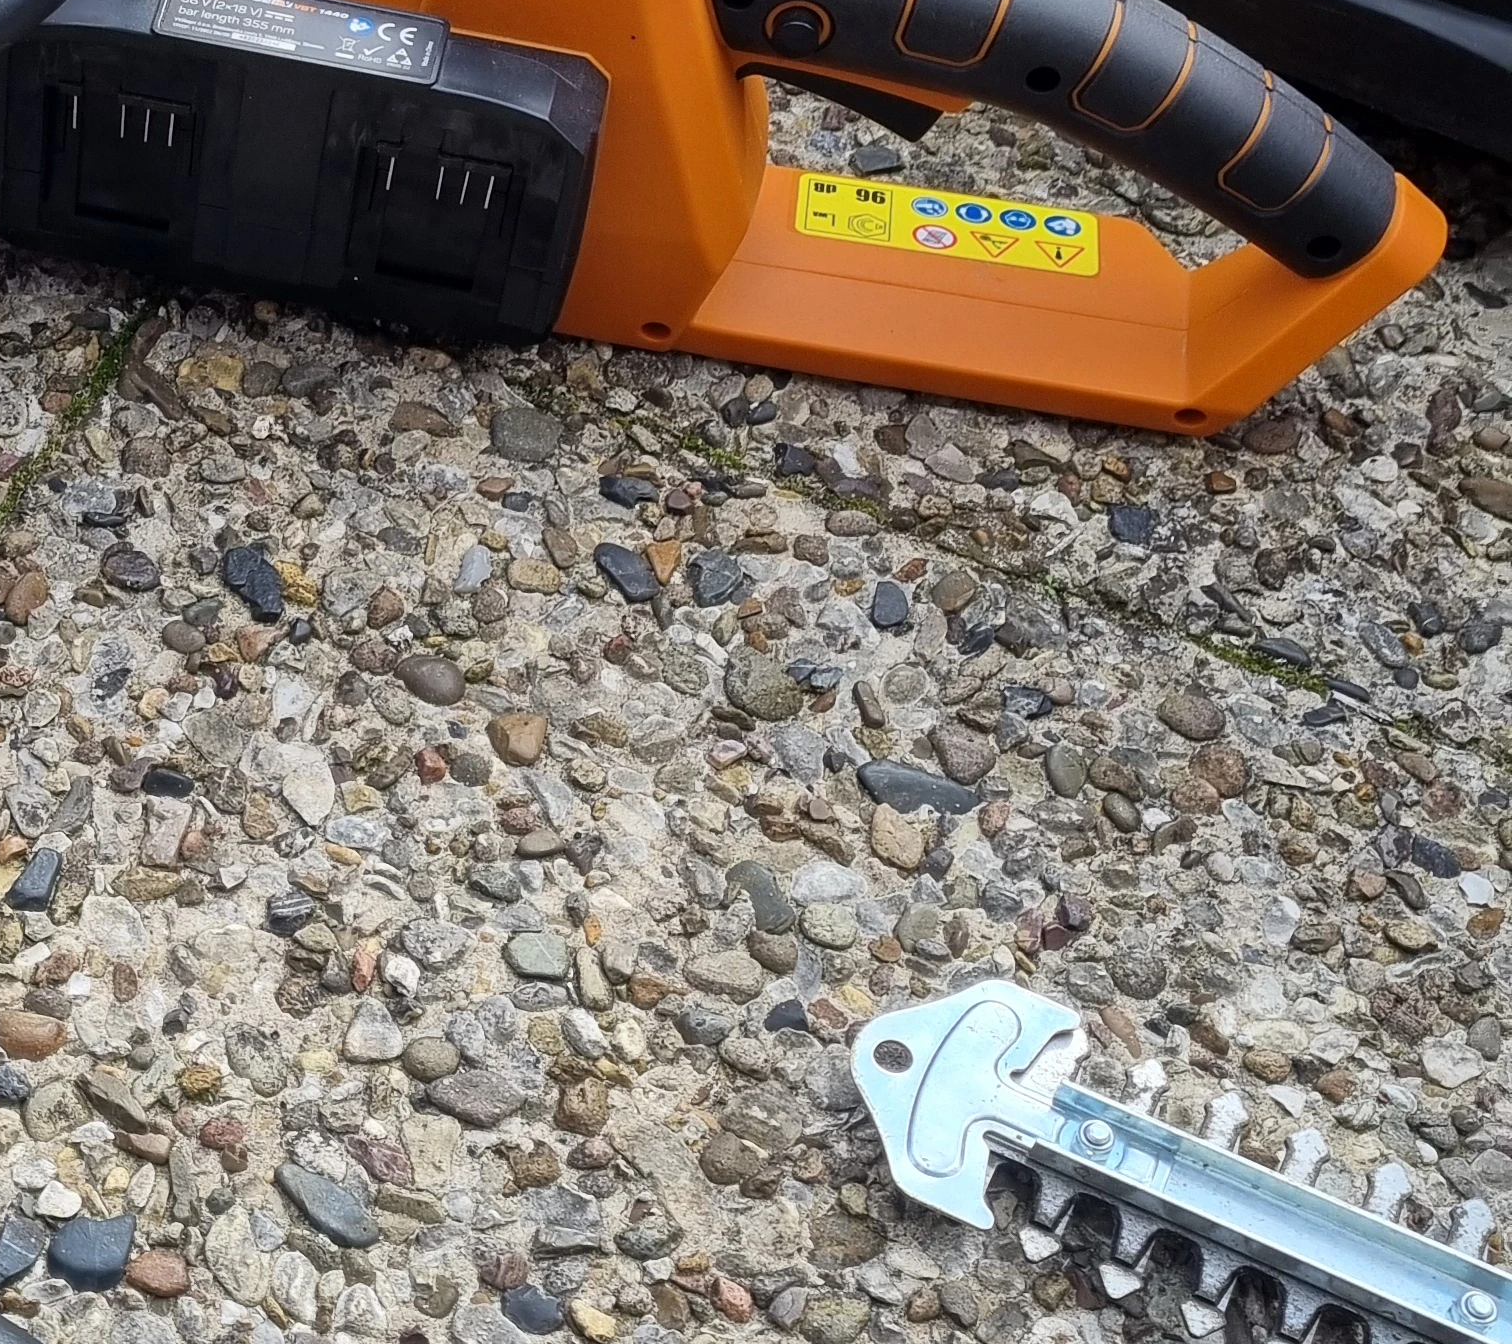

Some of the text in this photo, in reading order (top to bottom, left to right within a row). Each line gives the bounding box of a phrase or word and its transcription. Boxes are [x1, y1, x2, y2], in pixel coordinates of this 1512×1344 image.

[178, 5, 199, 18] bar
[200, 8, 240, 28] length
[242, 17, 269, 30] 355
[271, 24, 295, 36] mm
[855, 188, 886, 205] 96
